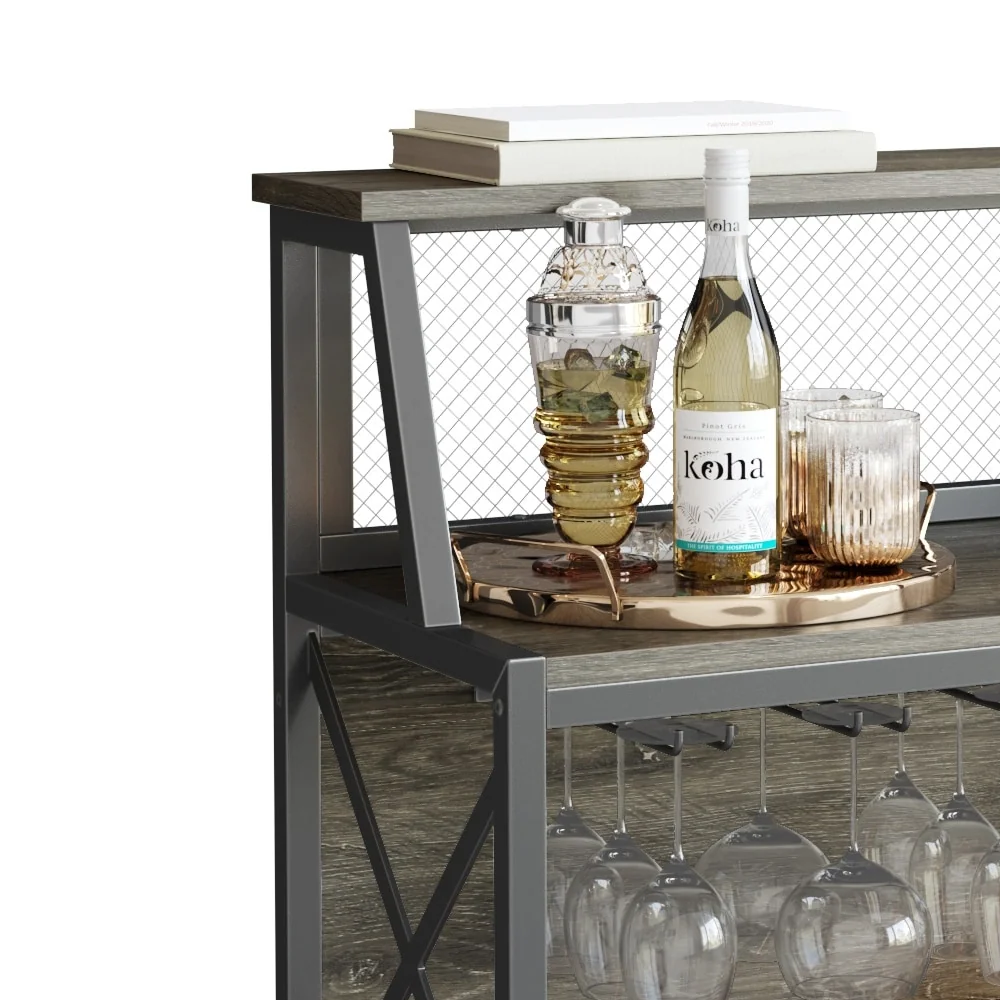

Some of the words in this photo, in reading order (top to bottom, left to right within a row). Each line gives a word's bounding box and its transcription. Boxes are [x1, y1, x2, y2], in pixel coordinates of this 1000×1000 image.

[706, 218, 740, 232] koha
[684, 450, 764, 480] koha
[726, 543, 763, 551] HOSPITALITY
